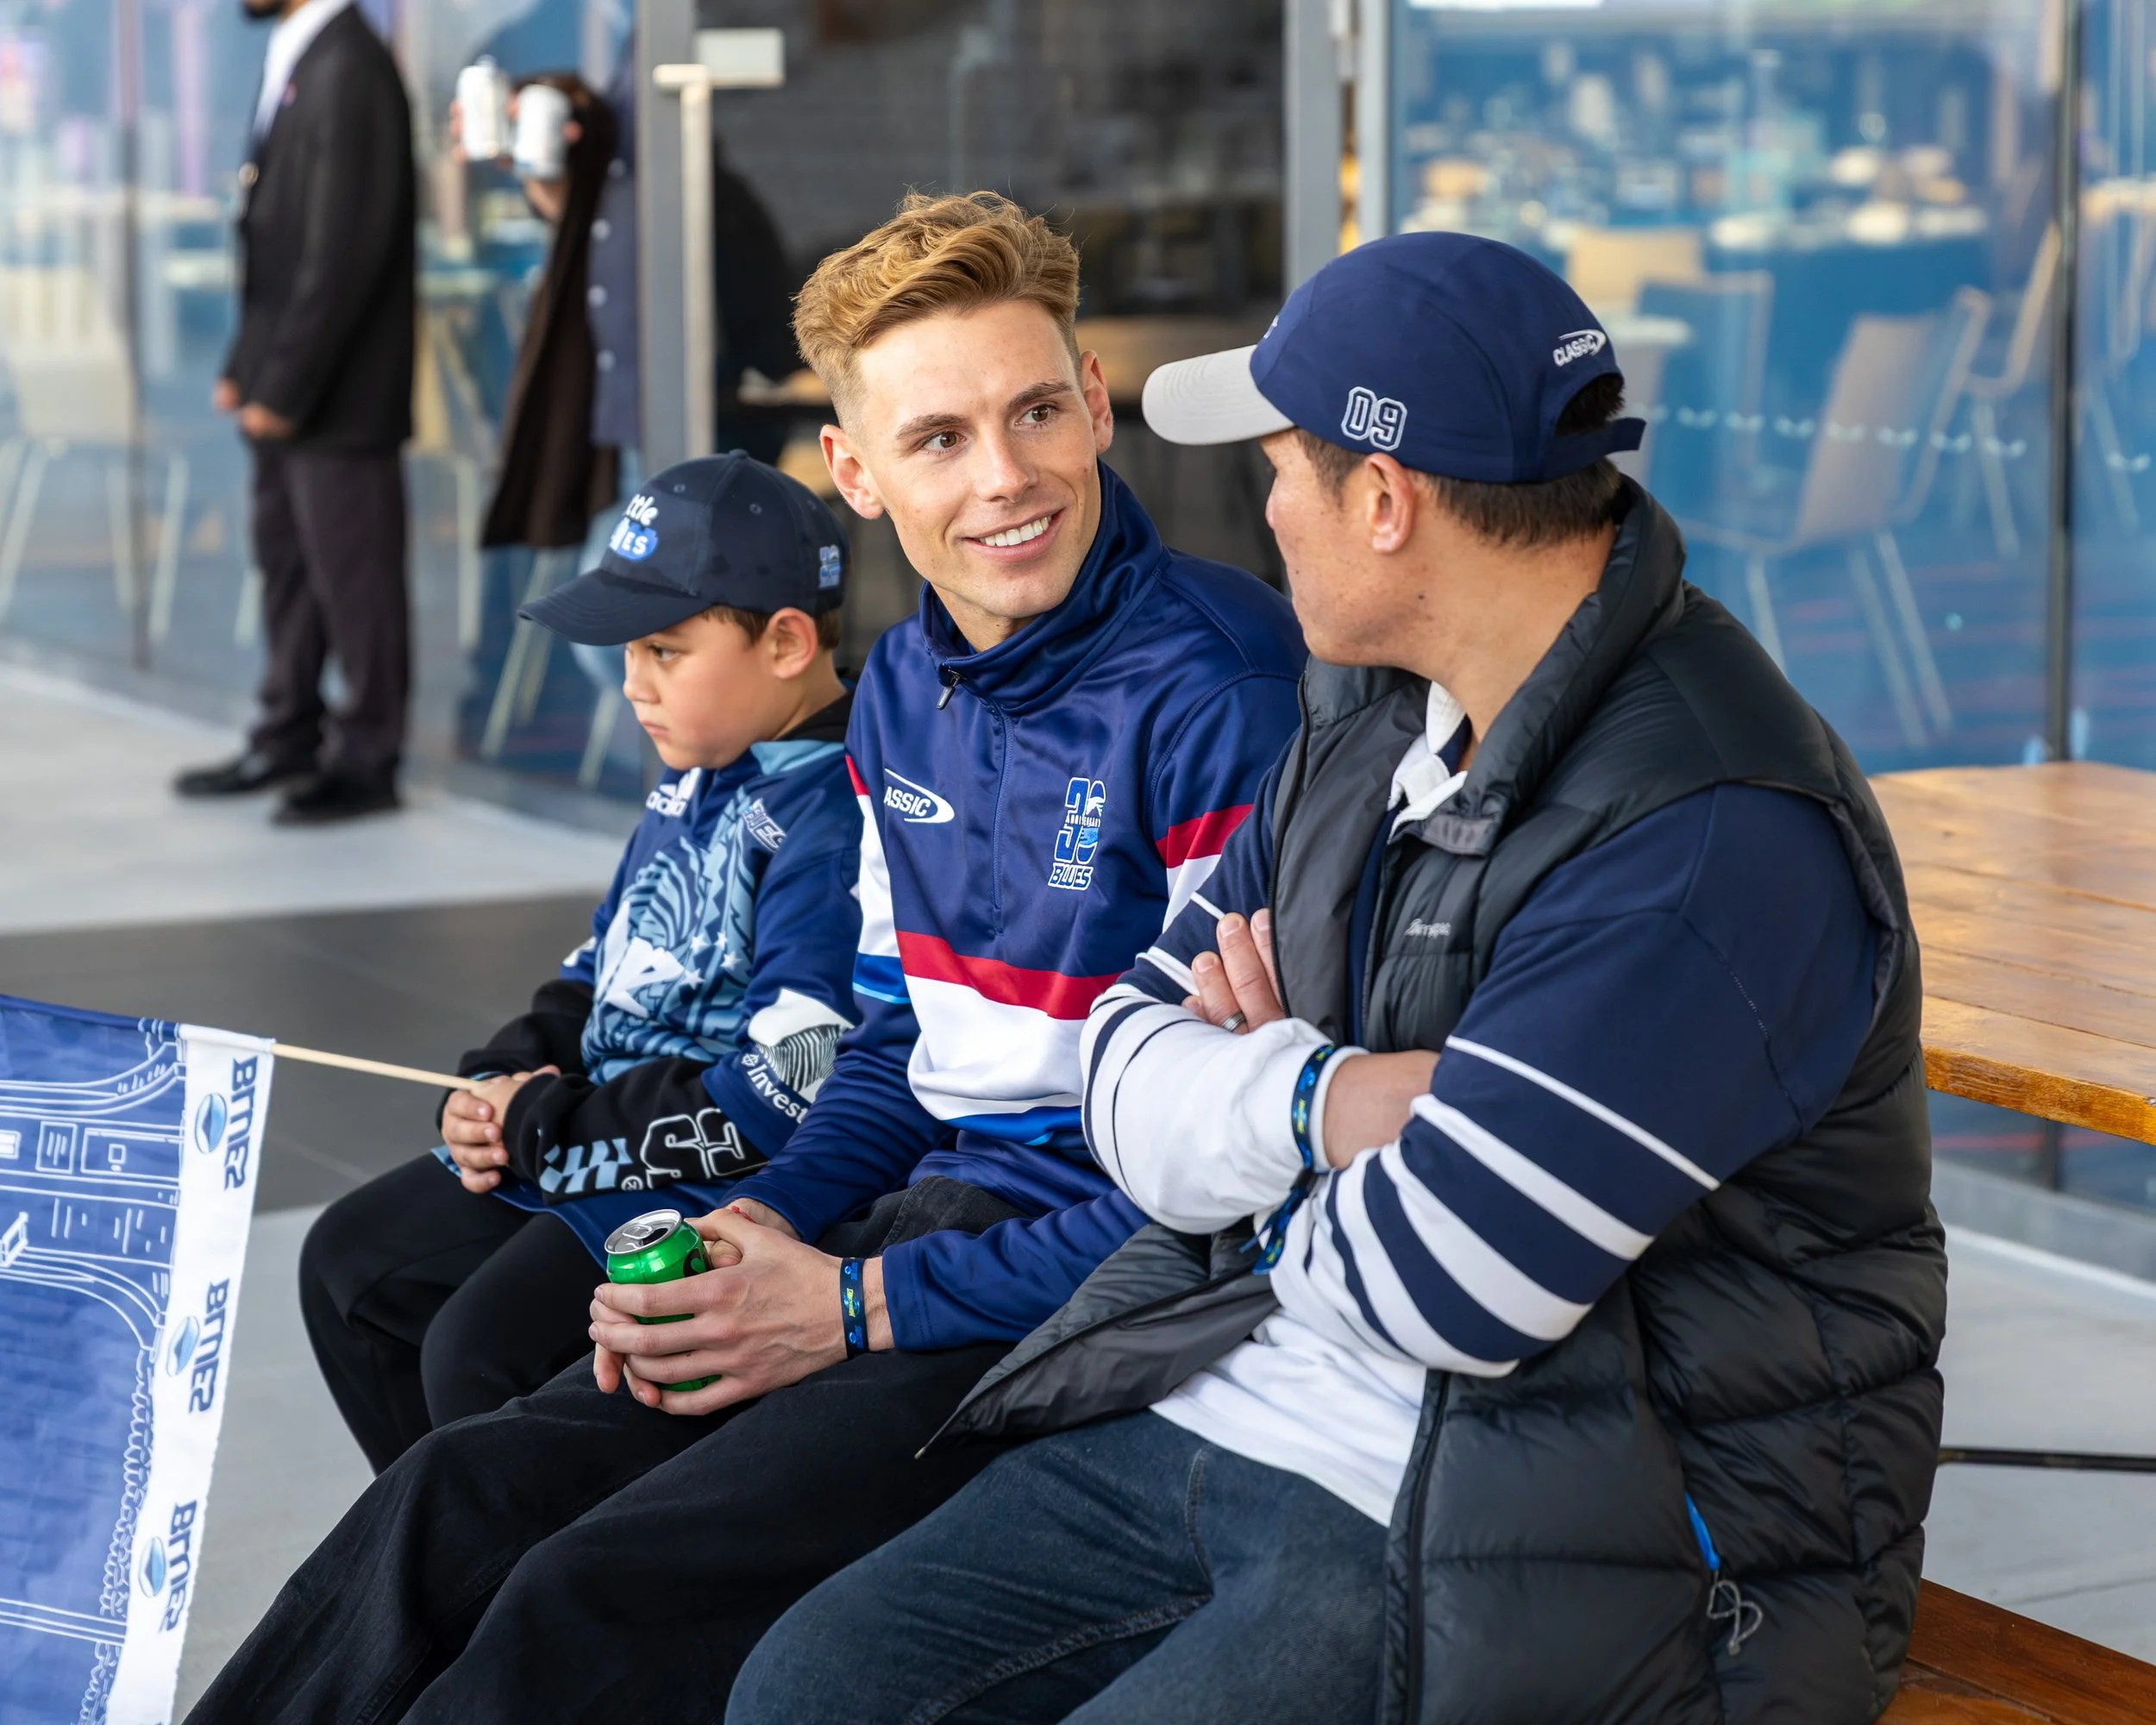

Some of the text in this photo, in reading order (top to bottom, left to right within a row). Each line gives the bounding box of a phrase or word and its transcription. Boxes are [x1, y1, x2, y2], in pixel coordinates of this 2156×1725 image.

[1341, 386, 1407, 452] 09
[883, 786, 931, 818] ASSIC
[1049, 862, 1094, 891] BLUES
